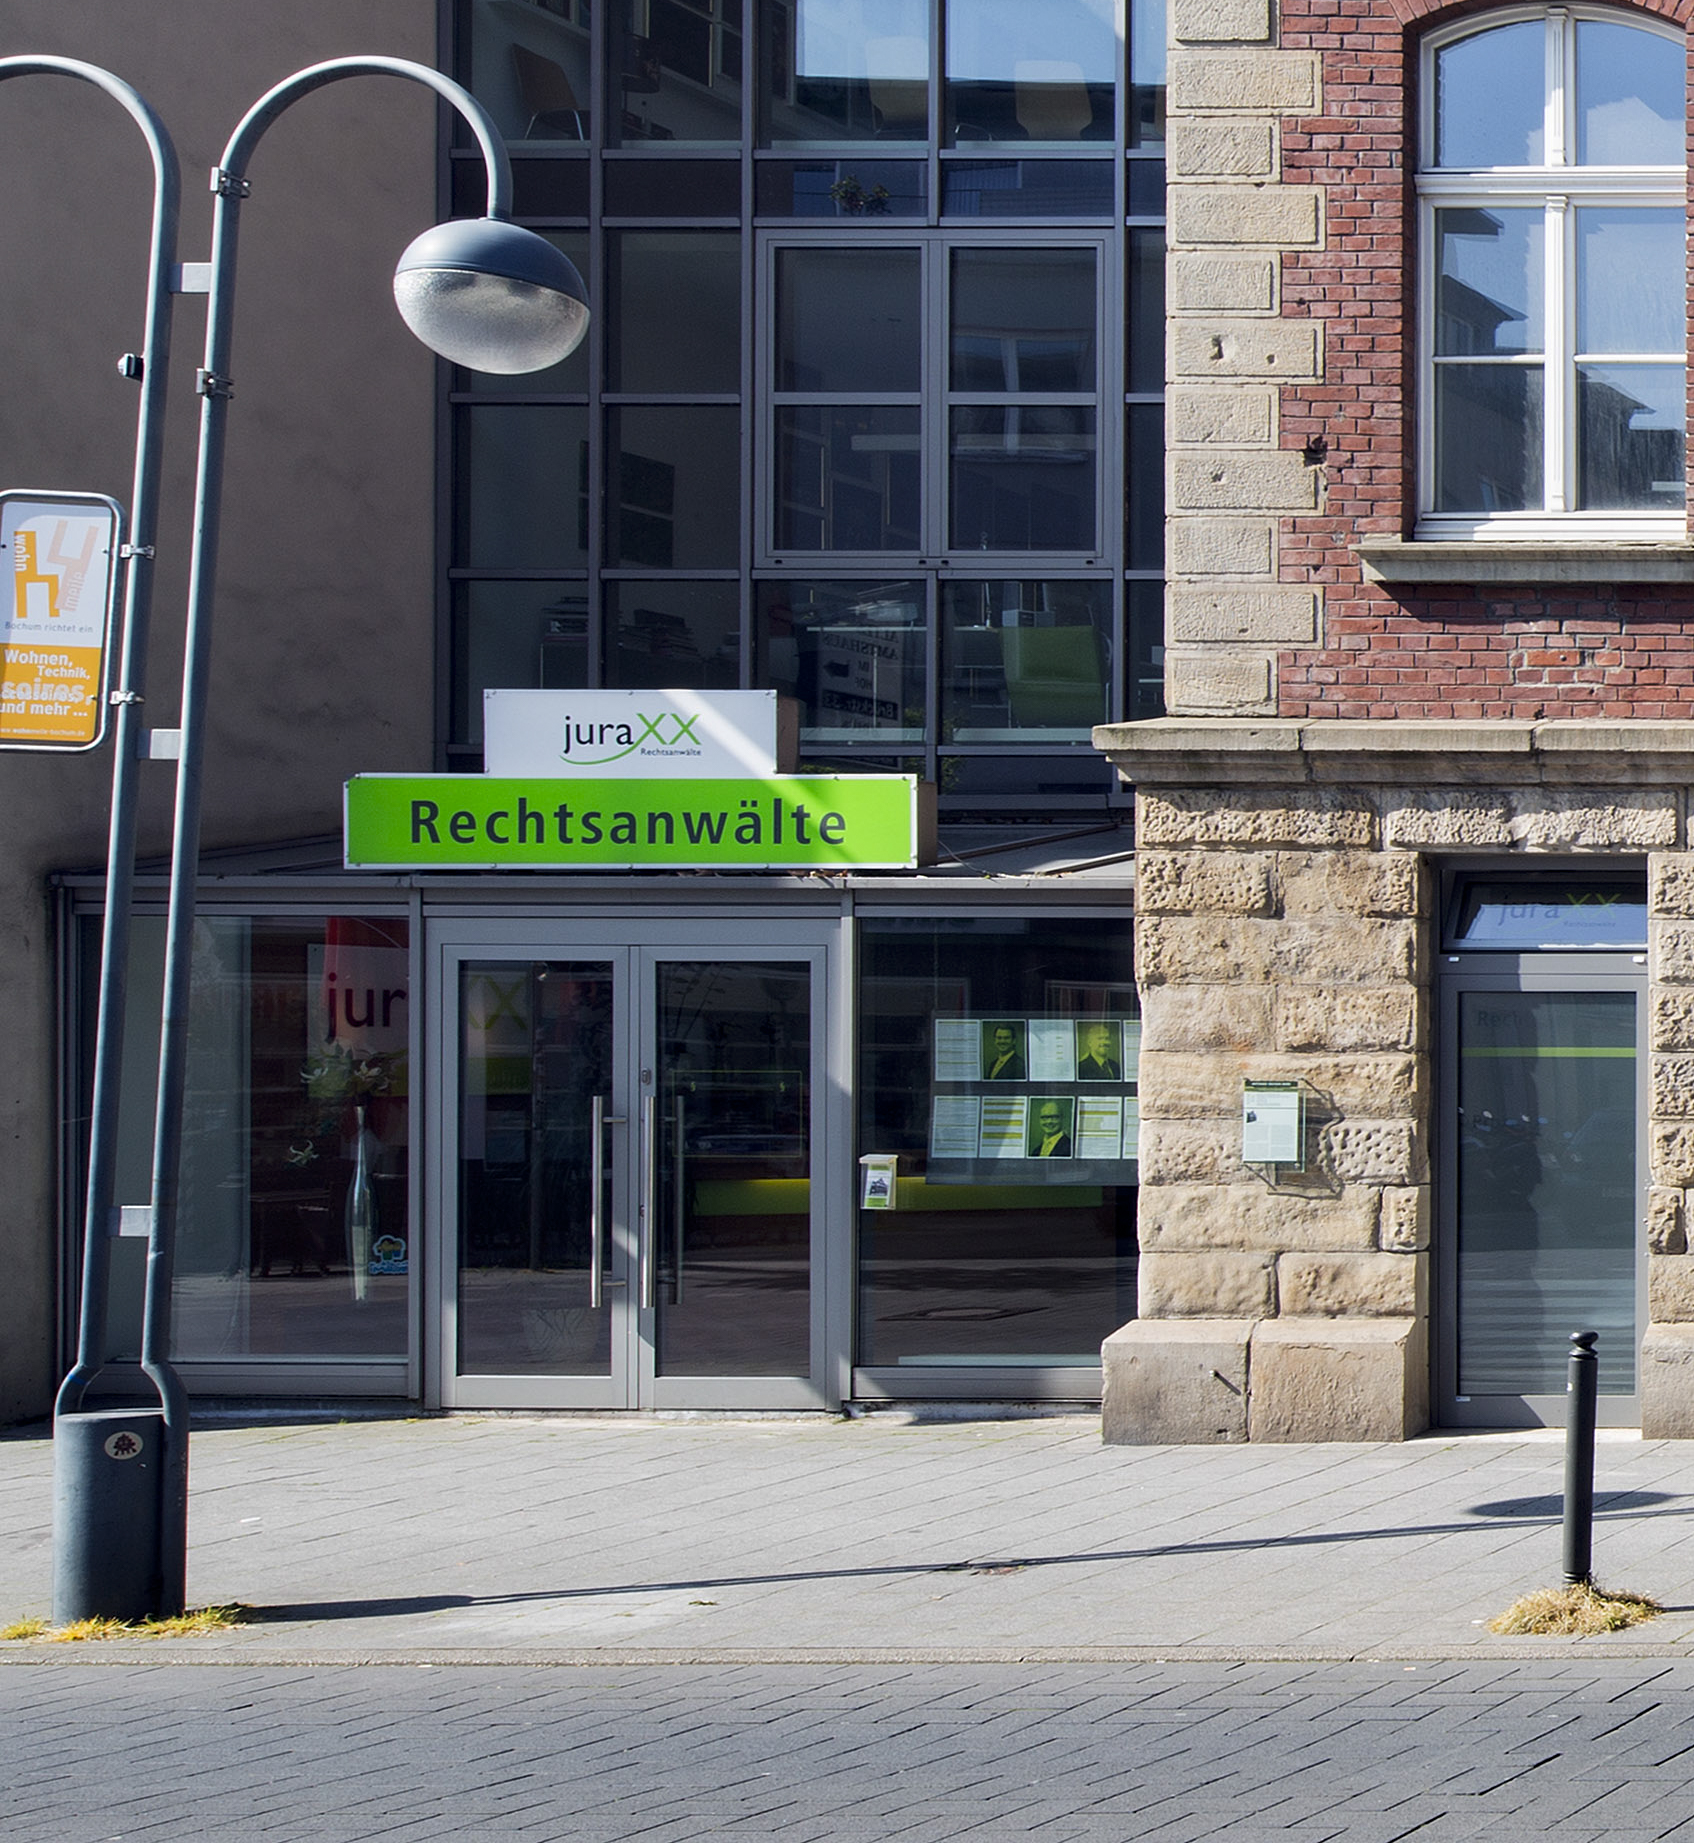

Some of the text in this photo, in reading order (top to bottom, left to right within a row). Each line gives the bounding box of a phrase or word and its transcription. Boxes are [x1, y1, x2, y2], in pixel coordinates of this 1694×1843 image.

[4, 648, 73, 667] Wohnen,
[37, 665, 91, 680] Technik,
[30, 702, 71, 716] mehr
[561, 713, 702, 761] juraXX
[640, 747, 702, 756] Rechtsanwälte
[410, 797, 847, 845] Rechtsanwälte
